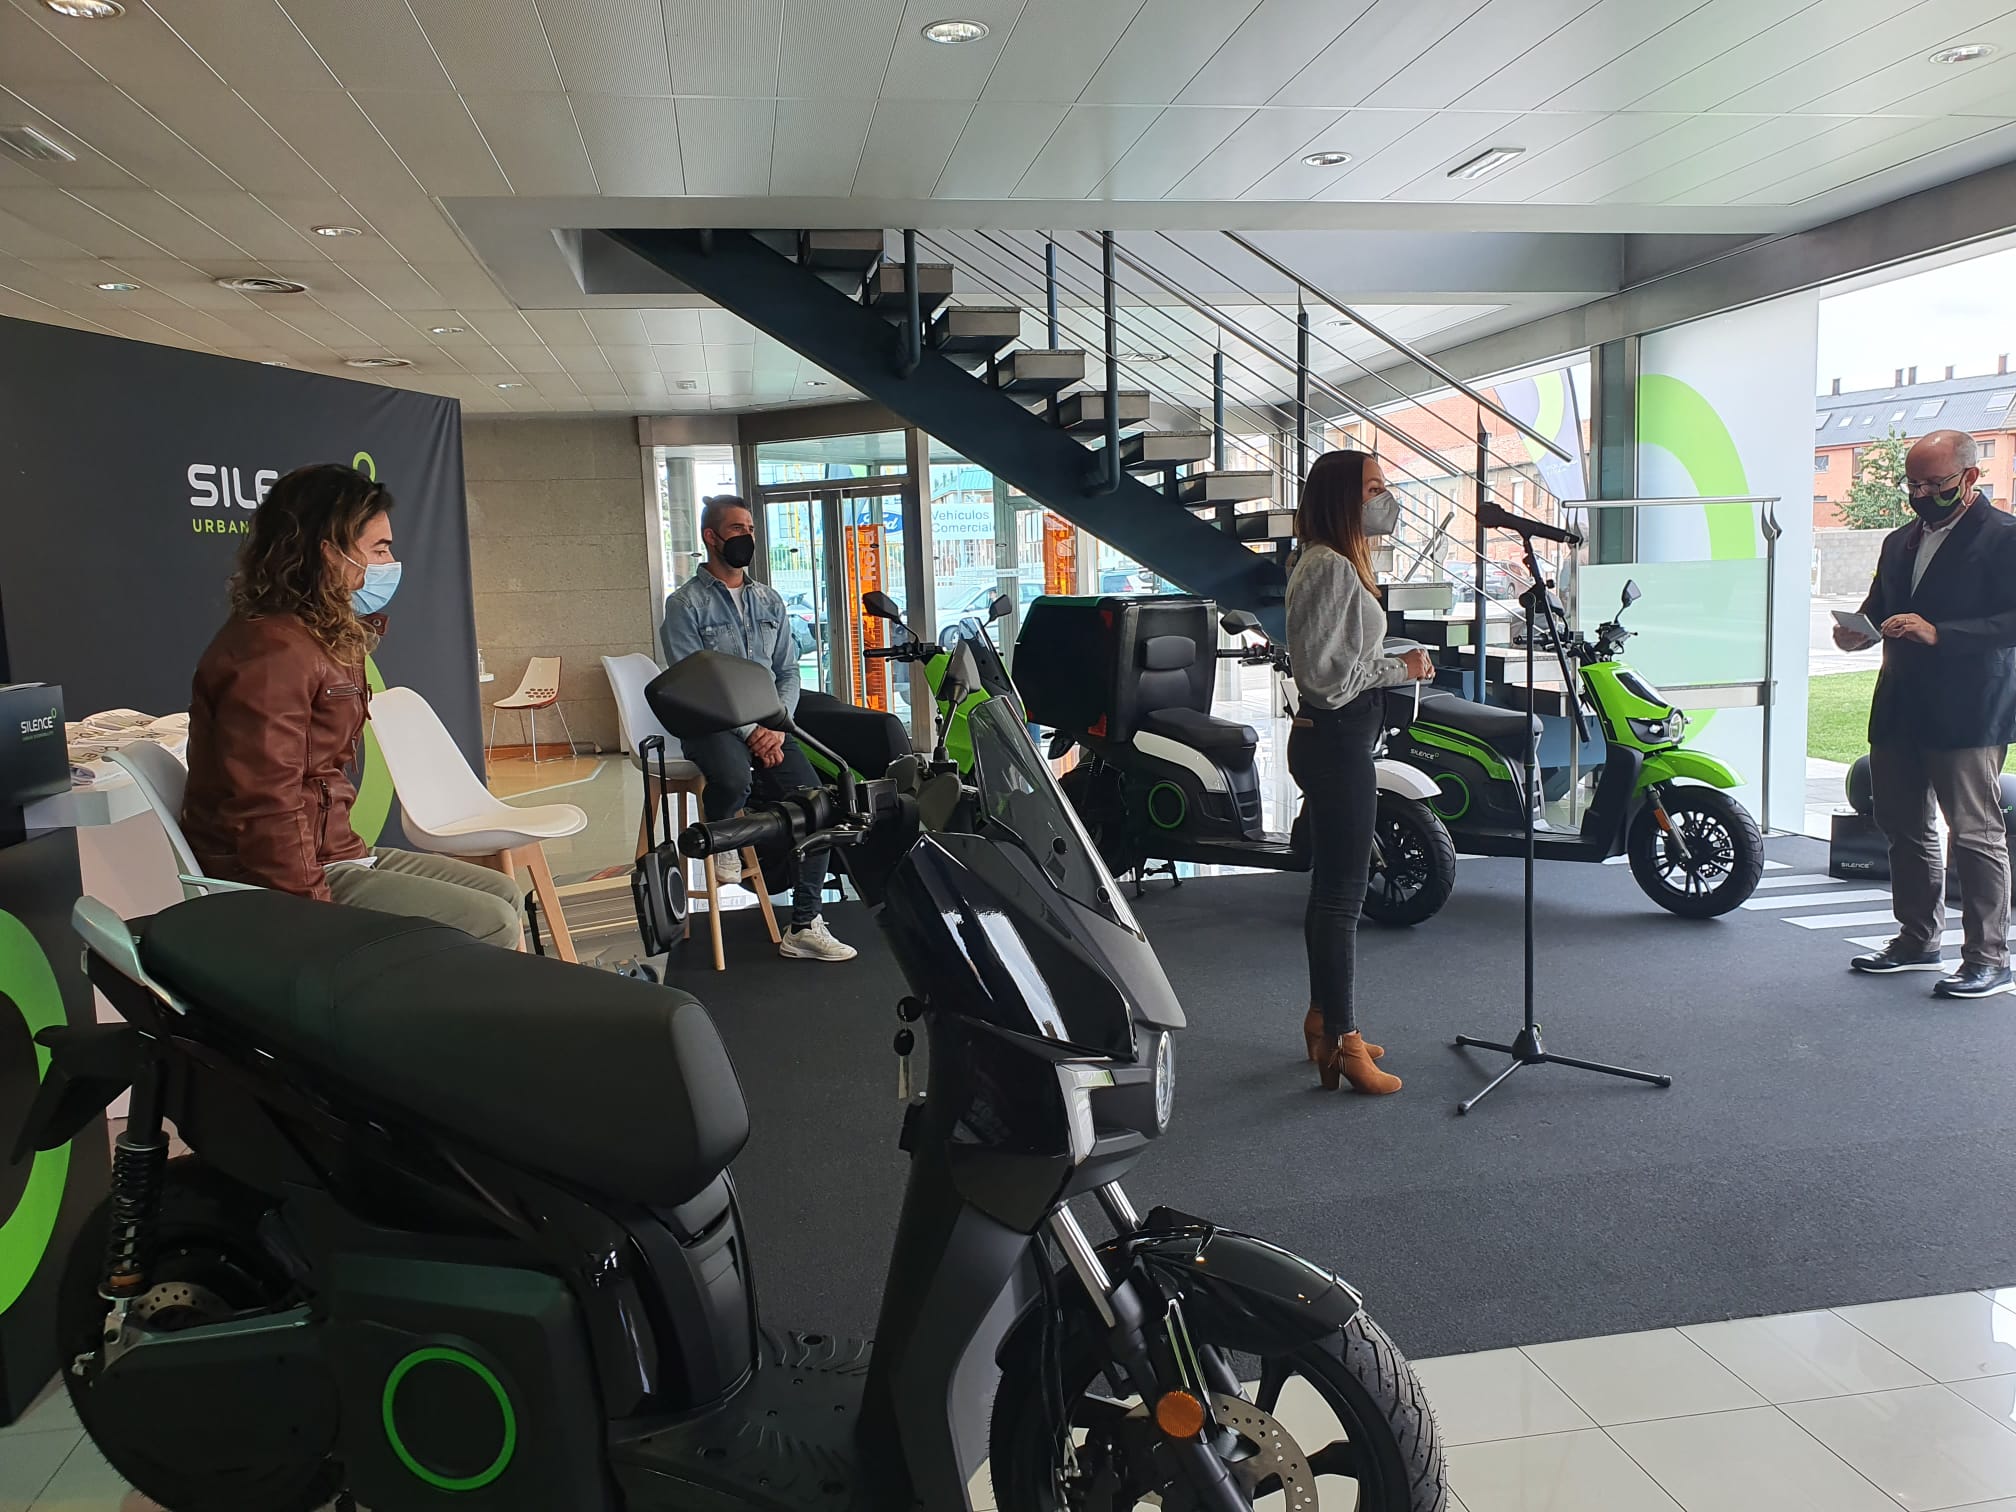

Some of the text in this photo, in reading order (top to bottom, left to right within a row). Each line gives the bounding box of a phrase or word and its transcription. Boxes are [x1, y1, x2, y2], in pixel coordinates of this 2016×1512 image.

[188, 464, 279, 509] SILE
[192, 518, 250, 534] URBAN
[931, 522, 995, 533] Comercial
[20, 716, 54, 734] SILENCE
[1410, 748, 1435, 760] SILENCE
